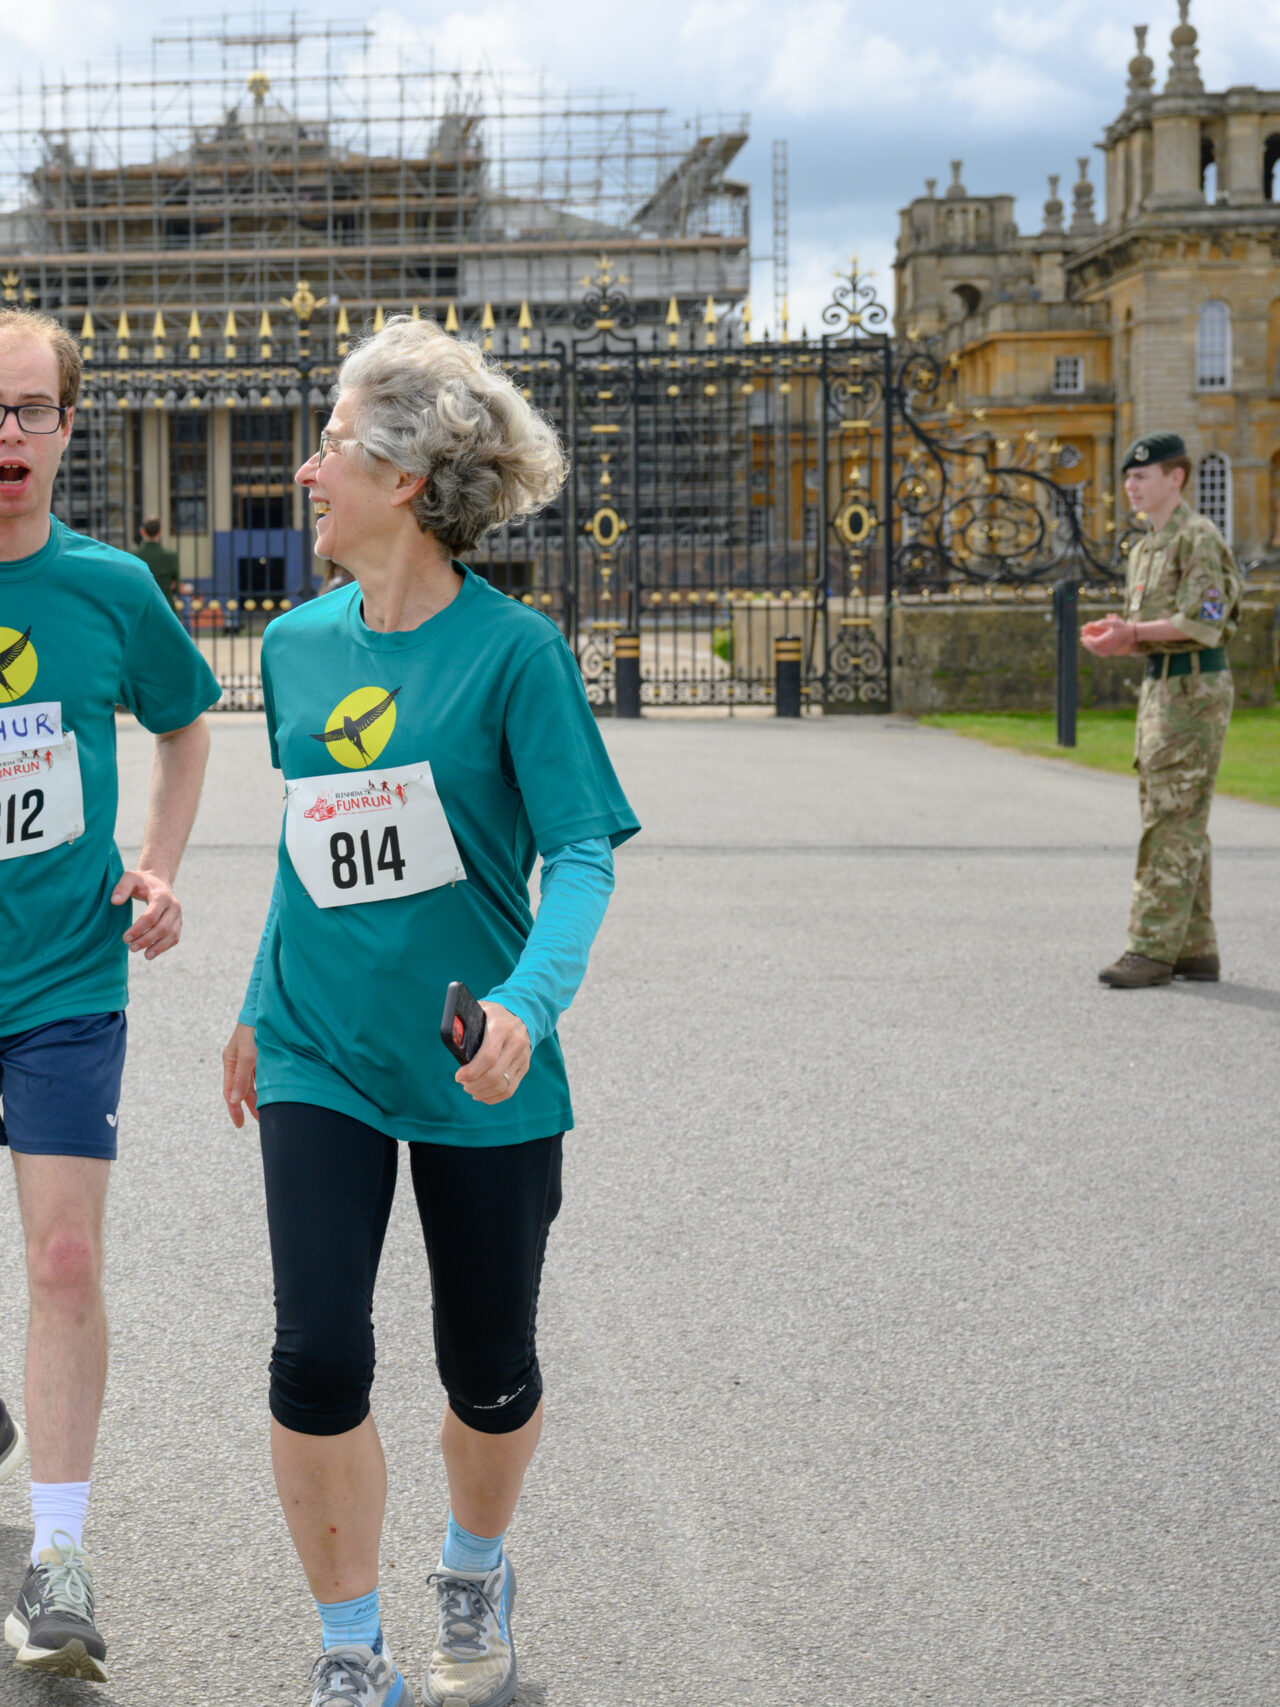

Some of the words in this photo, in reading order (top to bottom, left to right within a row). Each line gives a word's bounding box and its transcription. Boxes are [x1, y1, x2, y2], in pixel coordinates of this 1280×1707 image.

[13, 760, 40, 775] RUN
[336, 797, 360, 811] FUN
[361, 794, 391, 808] RUN
[329, 825, 406, 889] 814
